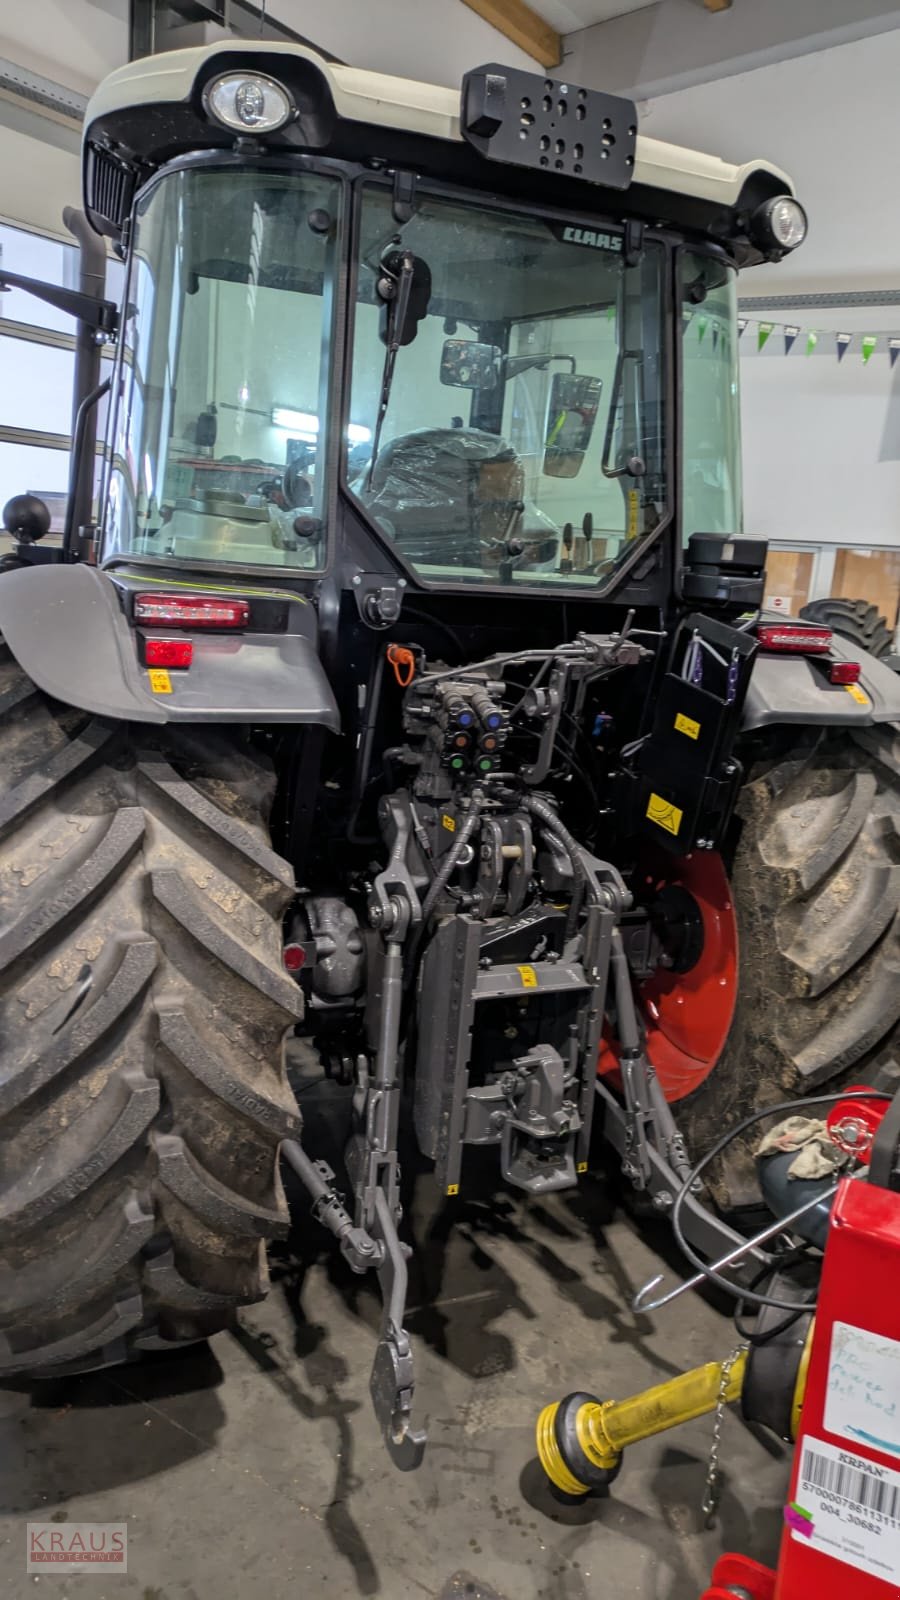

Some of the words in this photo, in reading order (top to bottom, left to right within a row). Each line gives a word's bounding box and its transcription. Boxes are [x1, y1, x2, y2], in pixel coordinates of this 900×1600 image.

[563, 227, 623, 252] CLAAS
[838, 1452, 885, 1477] KRPAN
[820, 1502, 883, 1535] 004_30682
